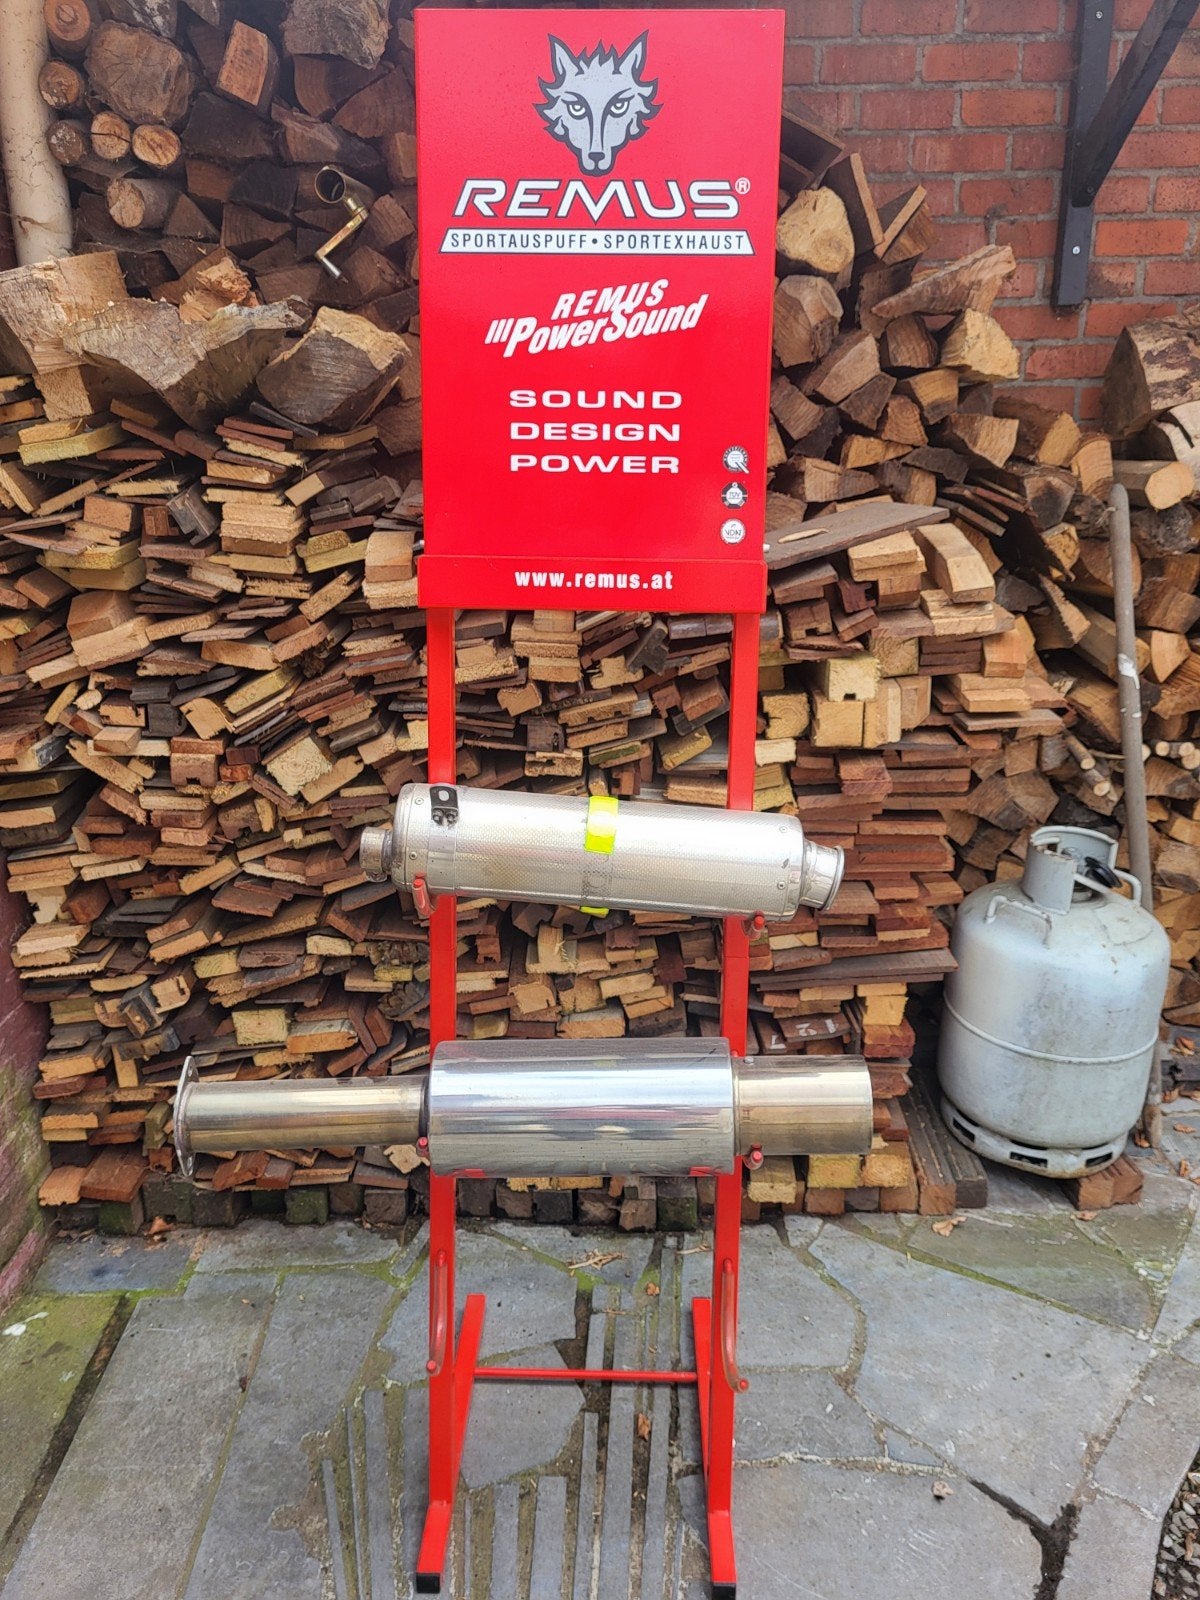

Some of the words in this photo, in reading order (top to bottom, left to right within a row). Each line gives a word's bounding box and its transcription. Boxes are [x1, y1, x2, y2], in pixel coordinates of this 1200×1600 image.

[453, 179, 739, 223] REMUS
[450, 233, 588, 250] SPORTAUSPUFF
[603, 234, 744, 250] SPORTEXHAUST
[551, 278, 669, 320] REMUS
[509, 389, 683, 410] SOUND
[510, 422, 680, 442] DESIGN
[510, 454, 679, 474] POWER
[515, 570, 673, 590] www.remus.at
